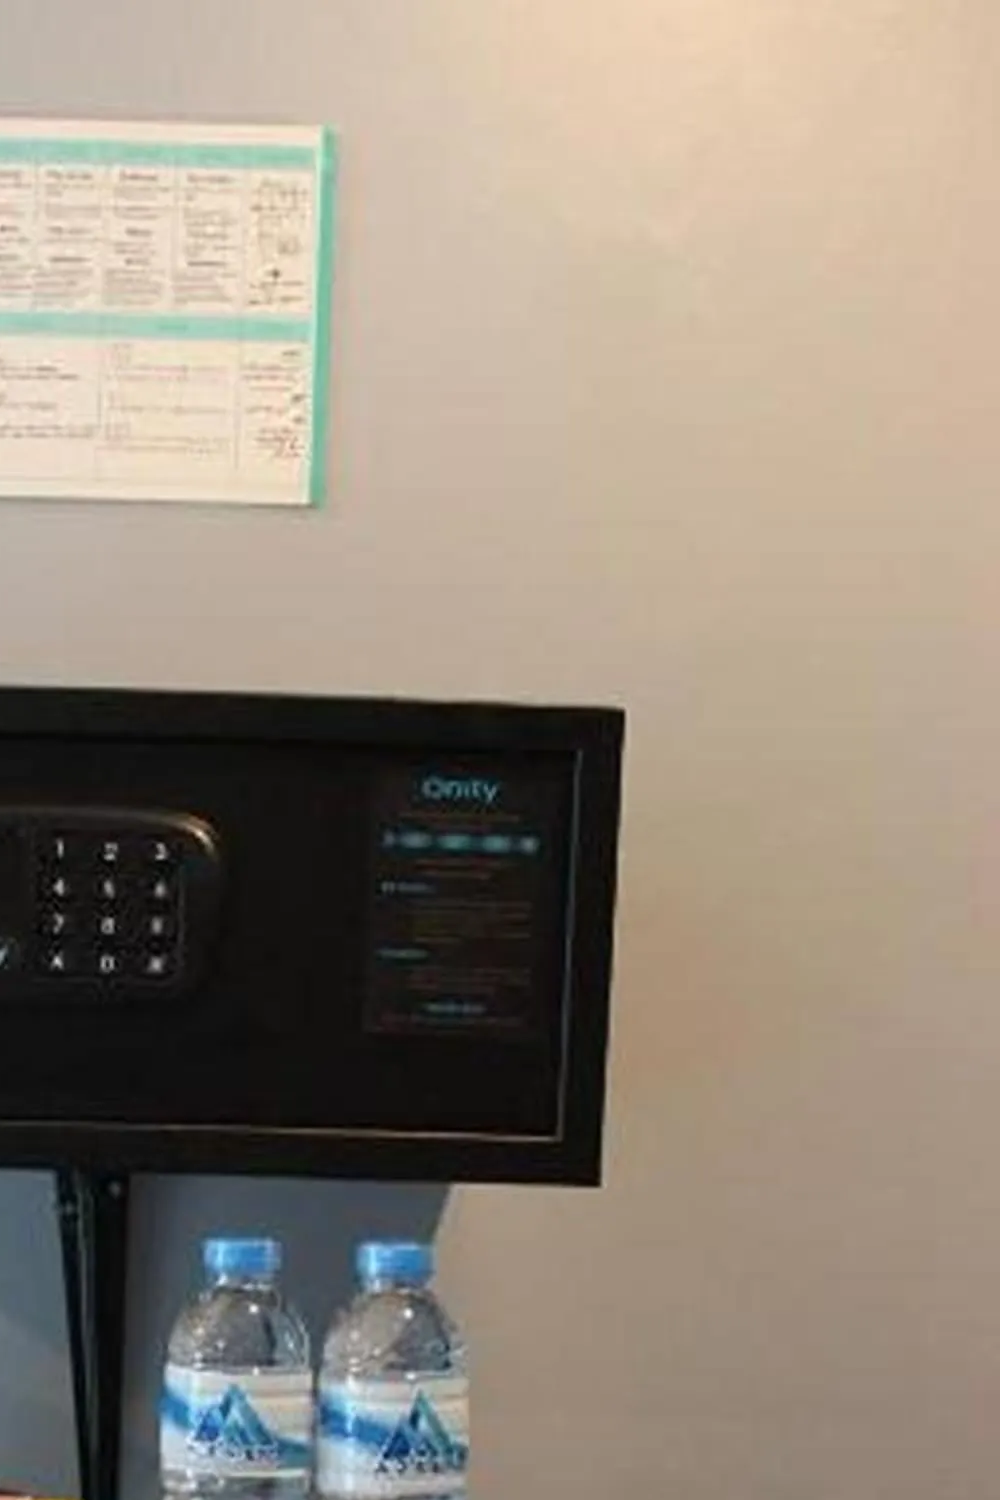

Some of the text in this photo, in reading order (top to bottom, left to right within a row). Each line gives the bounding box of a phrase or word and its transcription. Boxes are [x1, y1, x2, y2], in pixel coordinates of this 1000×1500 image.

[421, 775, 499, 805] Onity
[57, 839, 167, 861] 1 2 3
